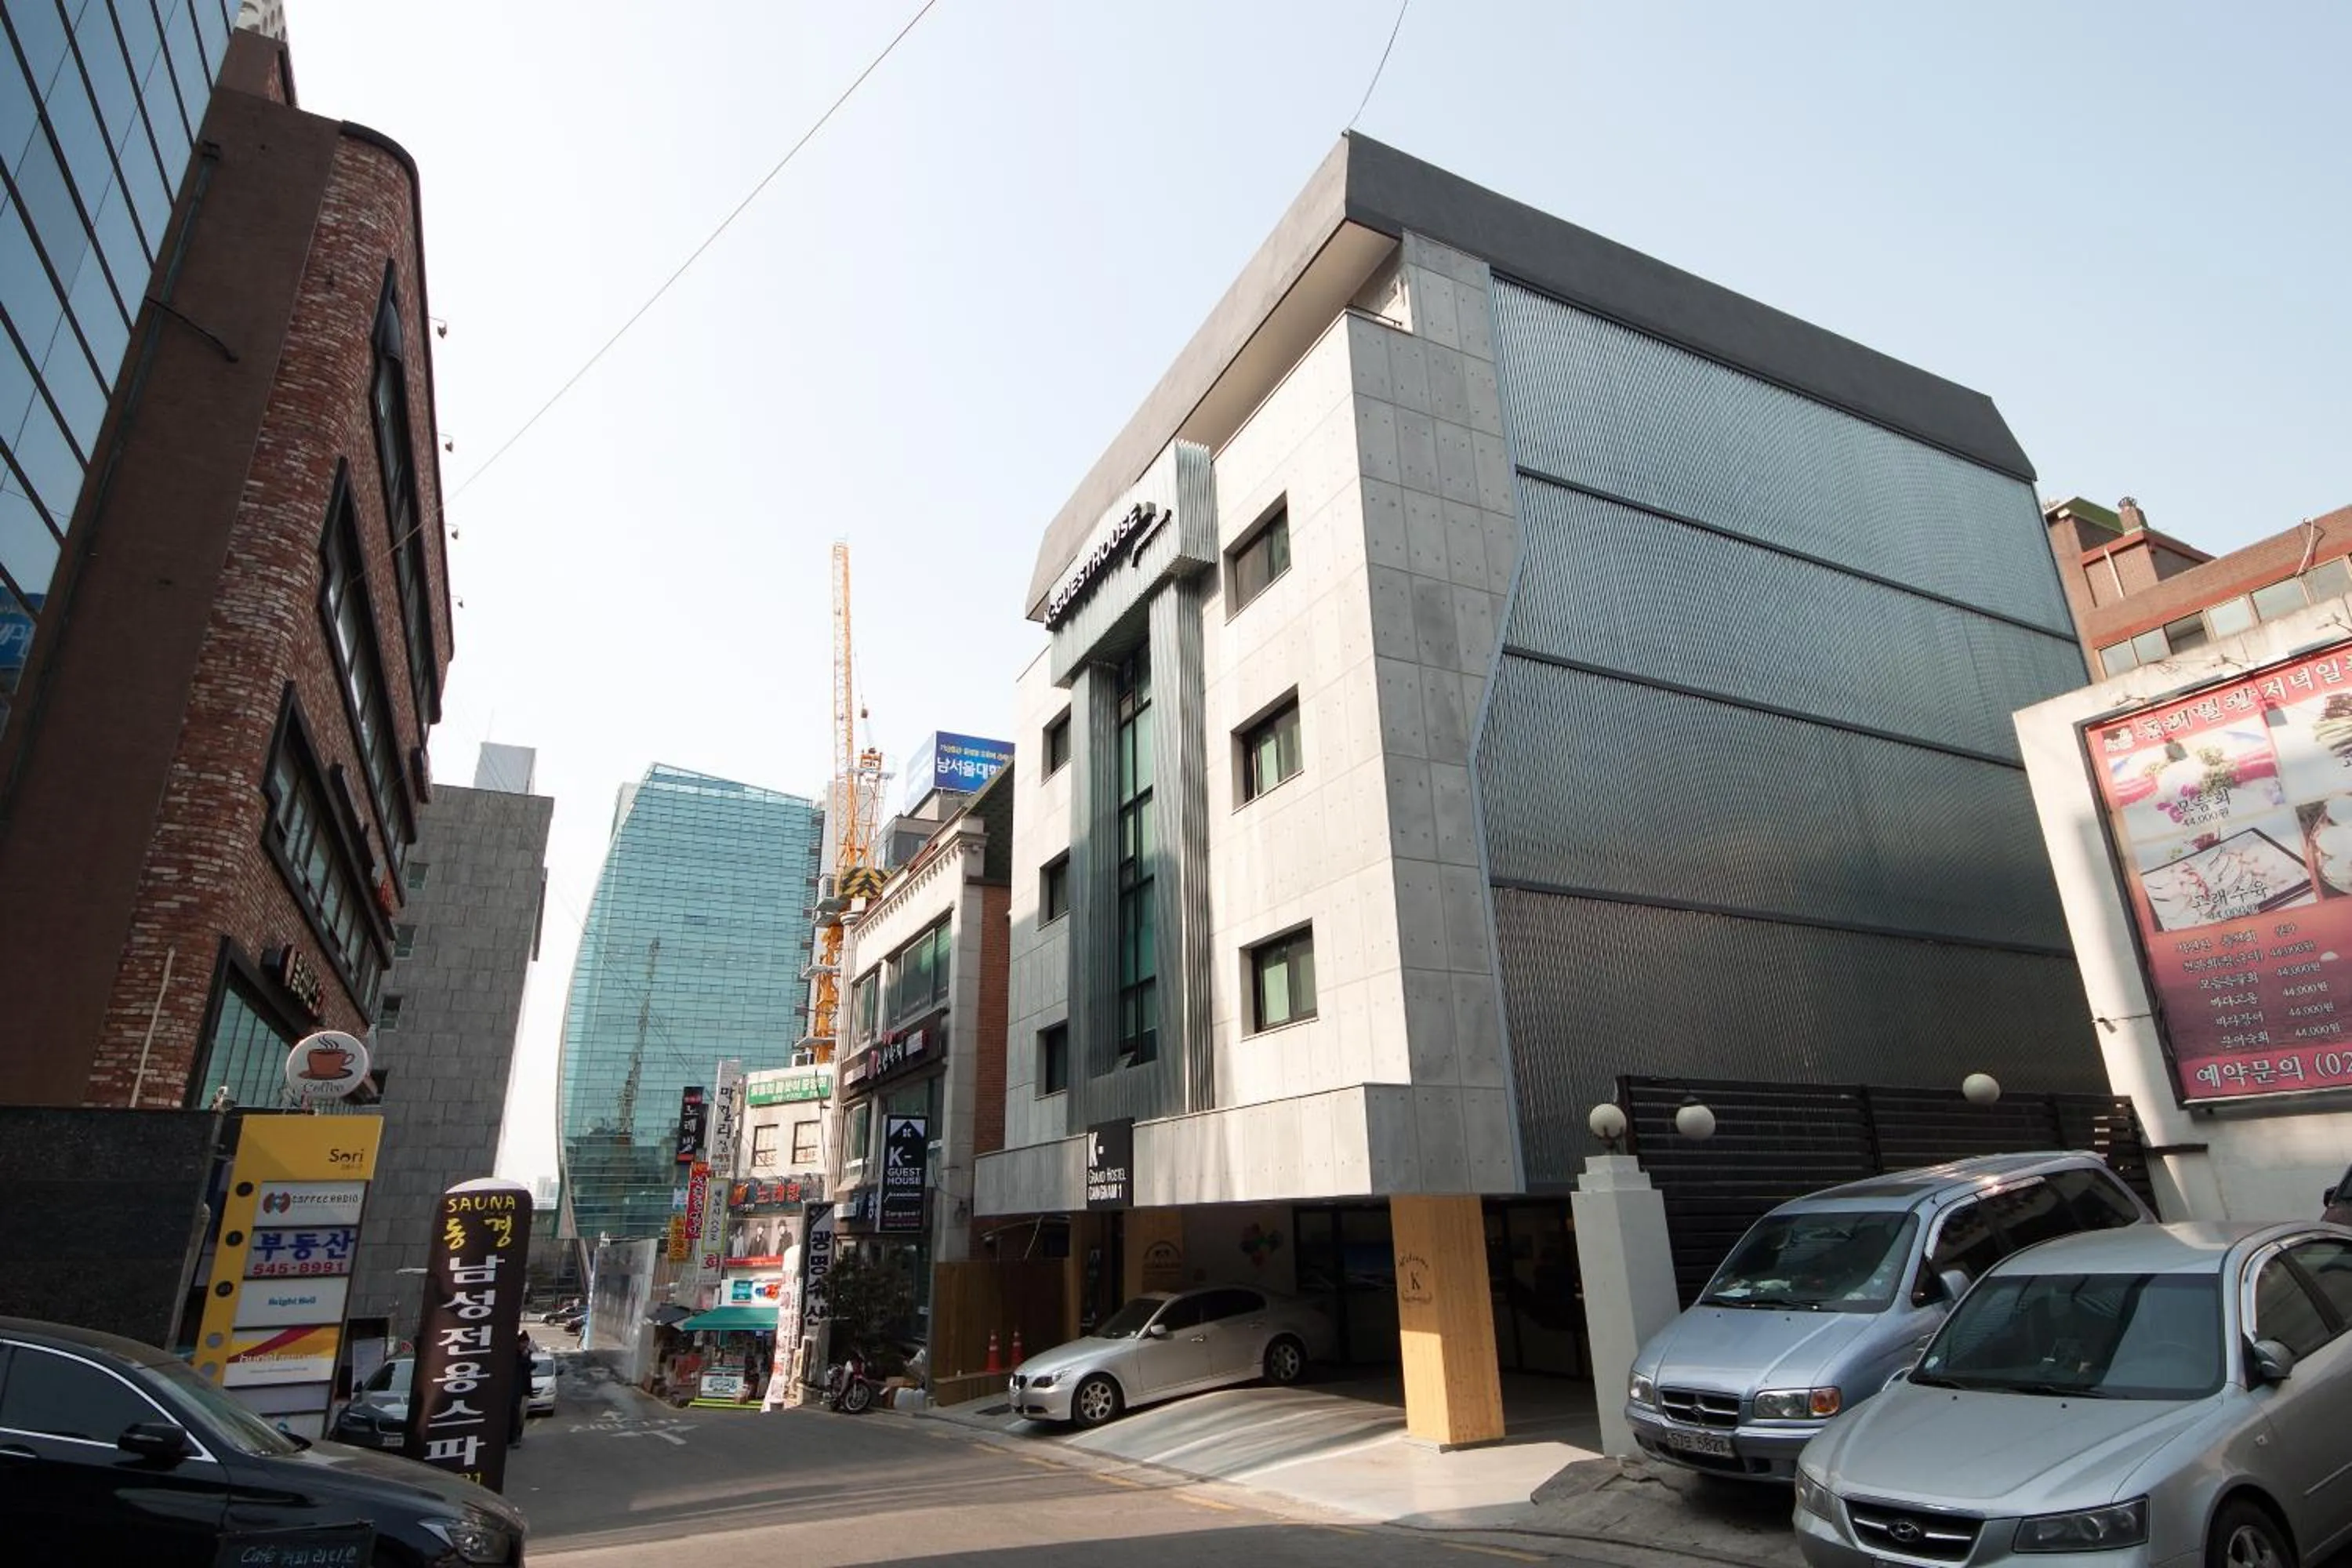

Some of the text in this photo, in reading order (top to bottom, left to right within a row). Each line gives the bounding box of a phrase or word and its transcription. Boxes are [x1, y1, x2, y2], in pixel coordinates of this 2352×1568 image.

[2262, 654, 2352, 701] 저녁일
[2196, 1056, 2305, 1088] 예약문의
[887, 1167, 922, 1177] GUEST
[887, 1176, 922, 1185] HOUSE
[447, 1196, 516, 1213] SAUNA
[253, 1228, 357, 1262] 부동산
[252, 1261, 345, 1276] 545-8991
[804, 1230, 832, 1327] 광명수산
[424, 1254, 506, 1466] 남성전용스파
